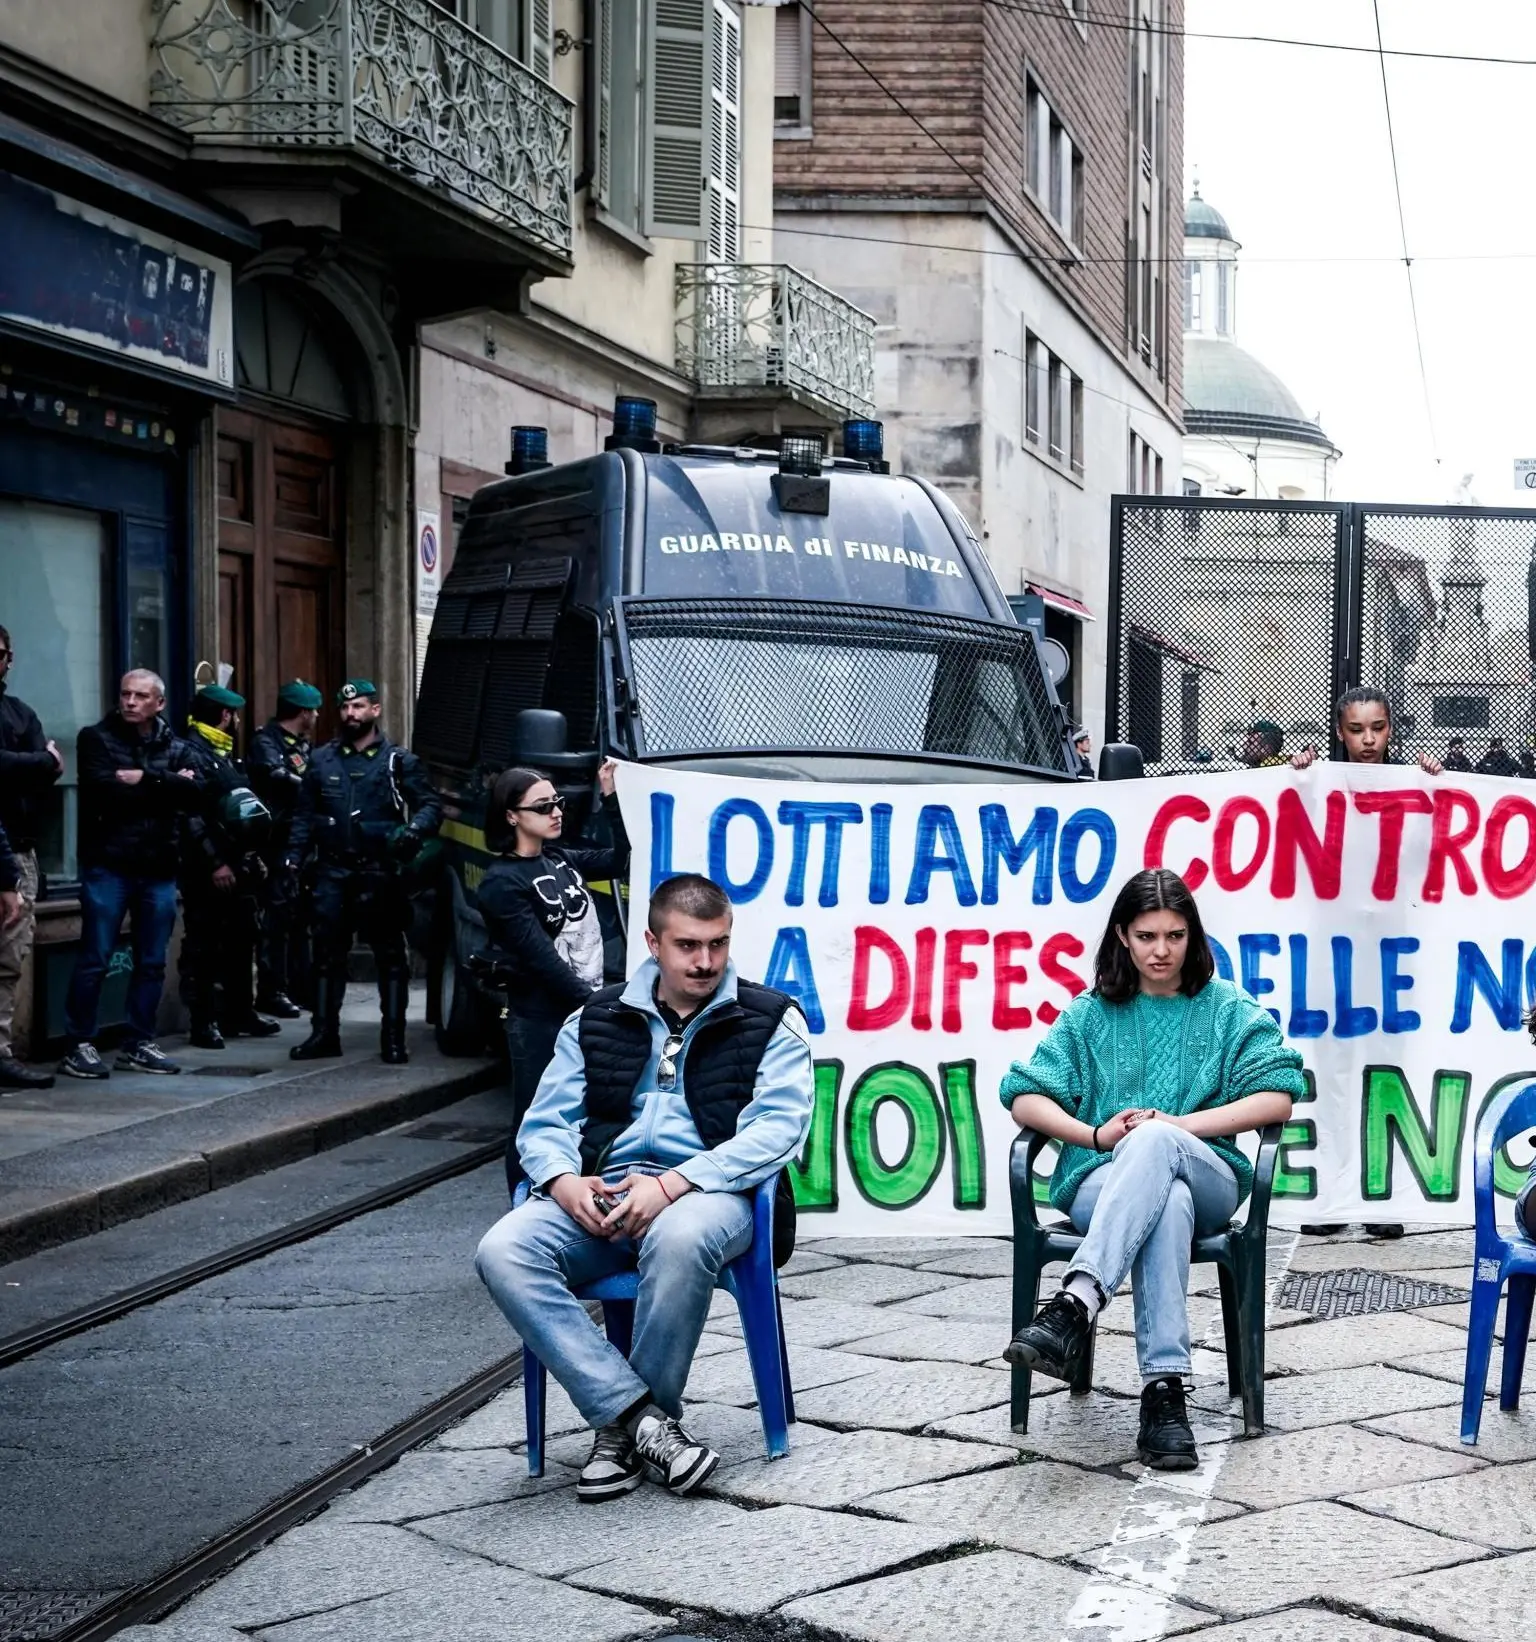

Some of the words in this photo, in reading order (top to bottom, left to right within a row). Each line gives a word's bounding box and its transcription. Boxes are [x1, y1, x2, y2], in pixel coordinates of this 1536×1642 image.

[660, 532, 794, 554] GUARDIA
[804, 537, 833, 556] di
[843, 540, 964, 579] FINANZA
[649, 791, 1117, 907] LOTTIAMO
[847, 926, 1089, 1035] DIFES
